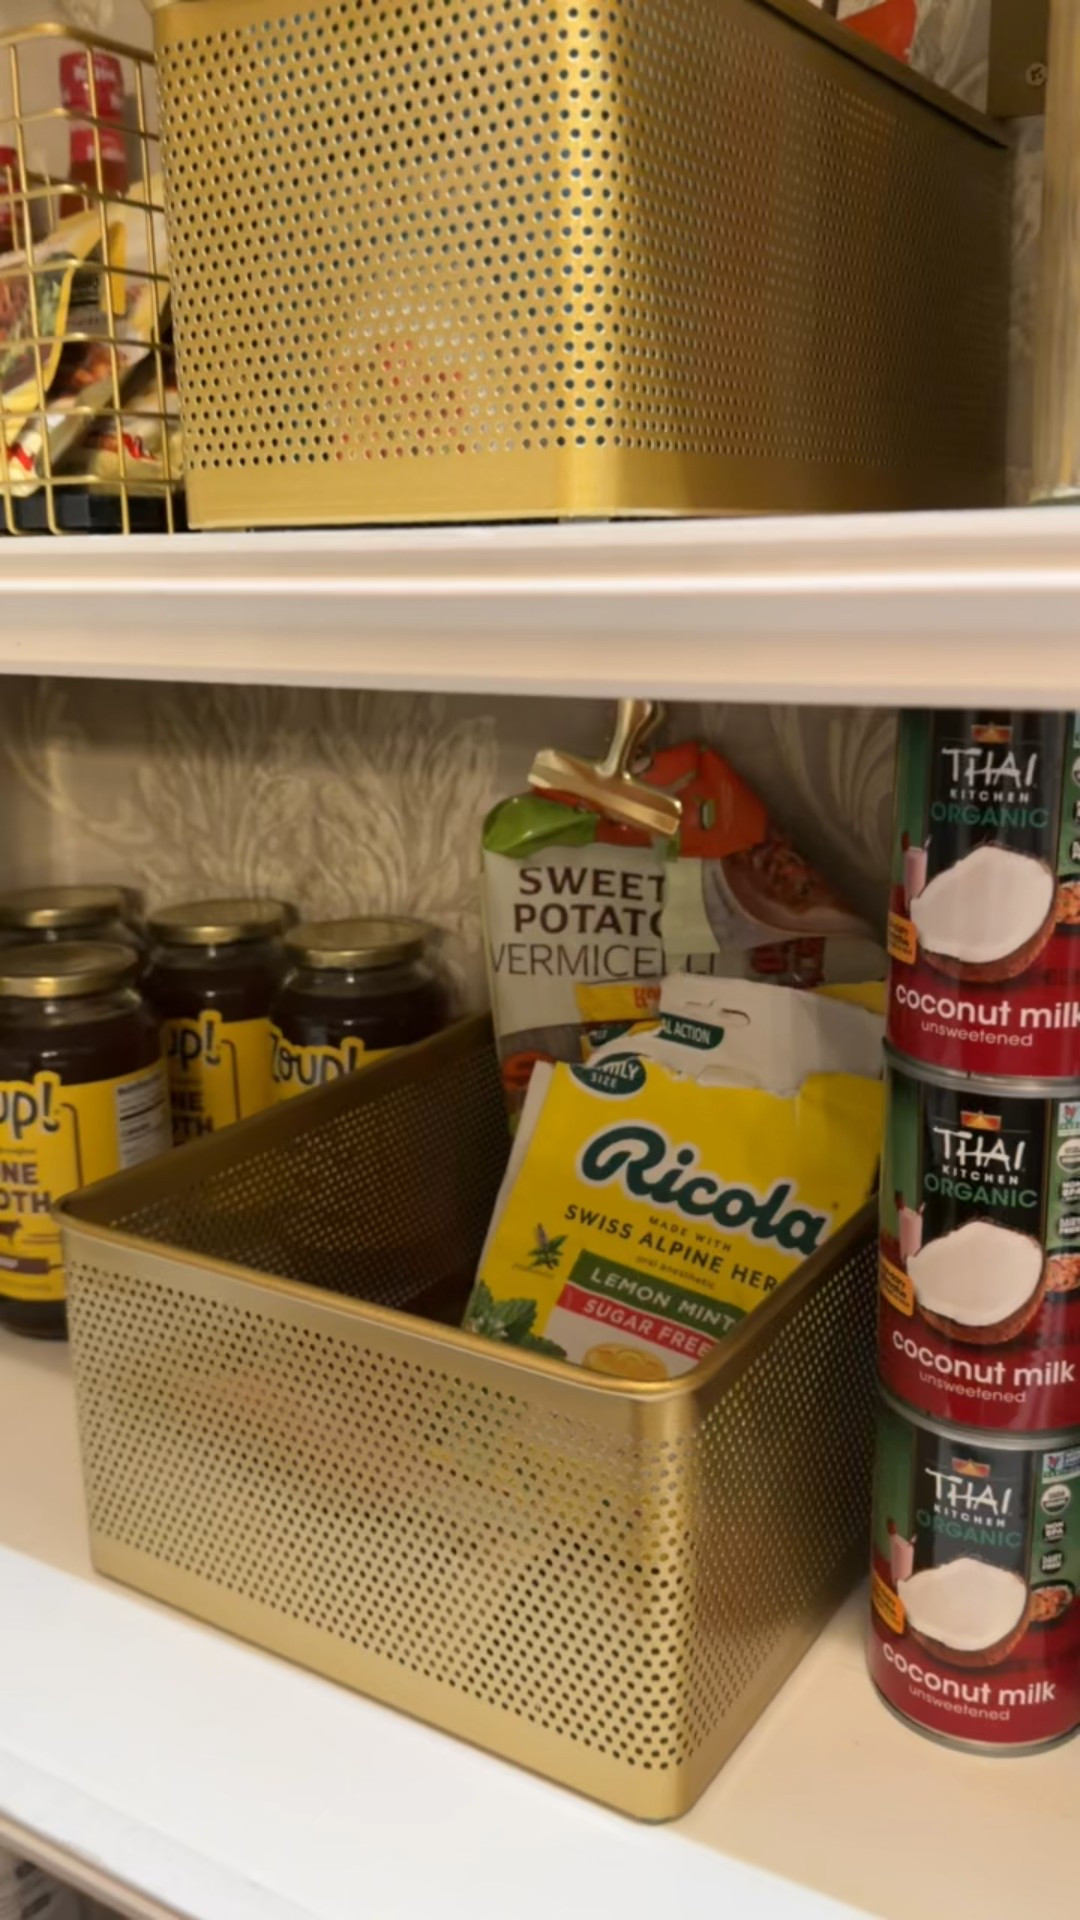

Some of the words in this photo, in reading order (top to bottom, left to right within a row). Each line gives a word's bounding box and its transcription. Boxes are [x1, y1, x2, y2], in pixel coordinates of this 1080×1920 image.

[941, 747, 1037, 788] THAI
[950, 788, 1029, 803] KITCHEN
[931, 802, 1049, 828] ORGANIC
[519, 866, 665, 902] SWEET
[896, 984, 1011, 1027] coconut
[673, 1021, 712, 1045] ACTION
[921, 1020, 1032, 1047] unsweetened
[590, 1072, 618, 1089] SIZE
[933, 1127, 1025, 1172] THAI
[582, 1126, 826, 1255] Ricola
[924, 1173, 1038, 1208] ORGANIC
[942, 1164, 1019, 1186] KITCHEN
[564, 1204, 634, 1240] SWISS
[639, 1232, 724, 1273] ALPINE
[649, 1215, 688, 1237] MADE
[695, 1232, 732, 1252] WITH
[590, 1267, 671, 1307] LEMON
[678, 1299, 736, 1333] MINT
[583, 1299, 653, 1335] SUGAR
[658, 1325, 713, 1357] FREE
[893, 1330, 1005, 1385] coconut
[1013, 1360, 1075, 1386] milk
[919, 1371, 1026, 1403] unsweetened
[925, 1467, 1012, 1515] THAI
[916, 1508, 1022, 1548] ORGANIC
[934, 1504, 1006, 1528] KITCHEN
[883, 1643, 991, 1705] coconut
[998, 1680, 1056, 1706] milk
[909, 1684, 1010, 1721] unsweetened
